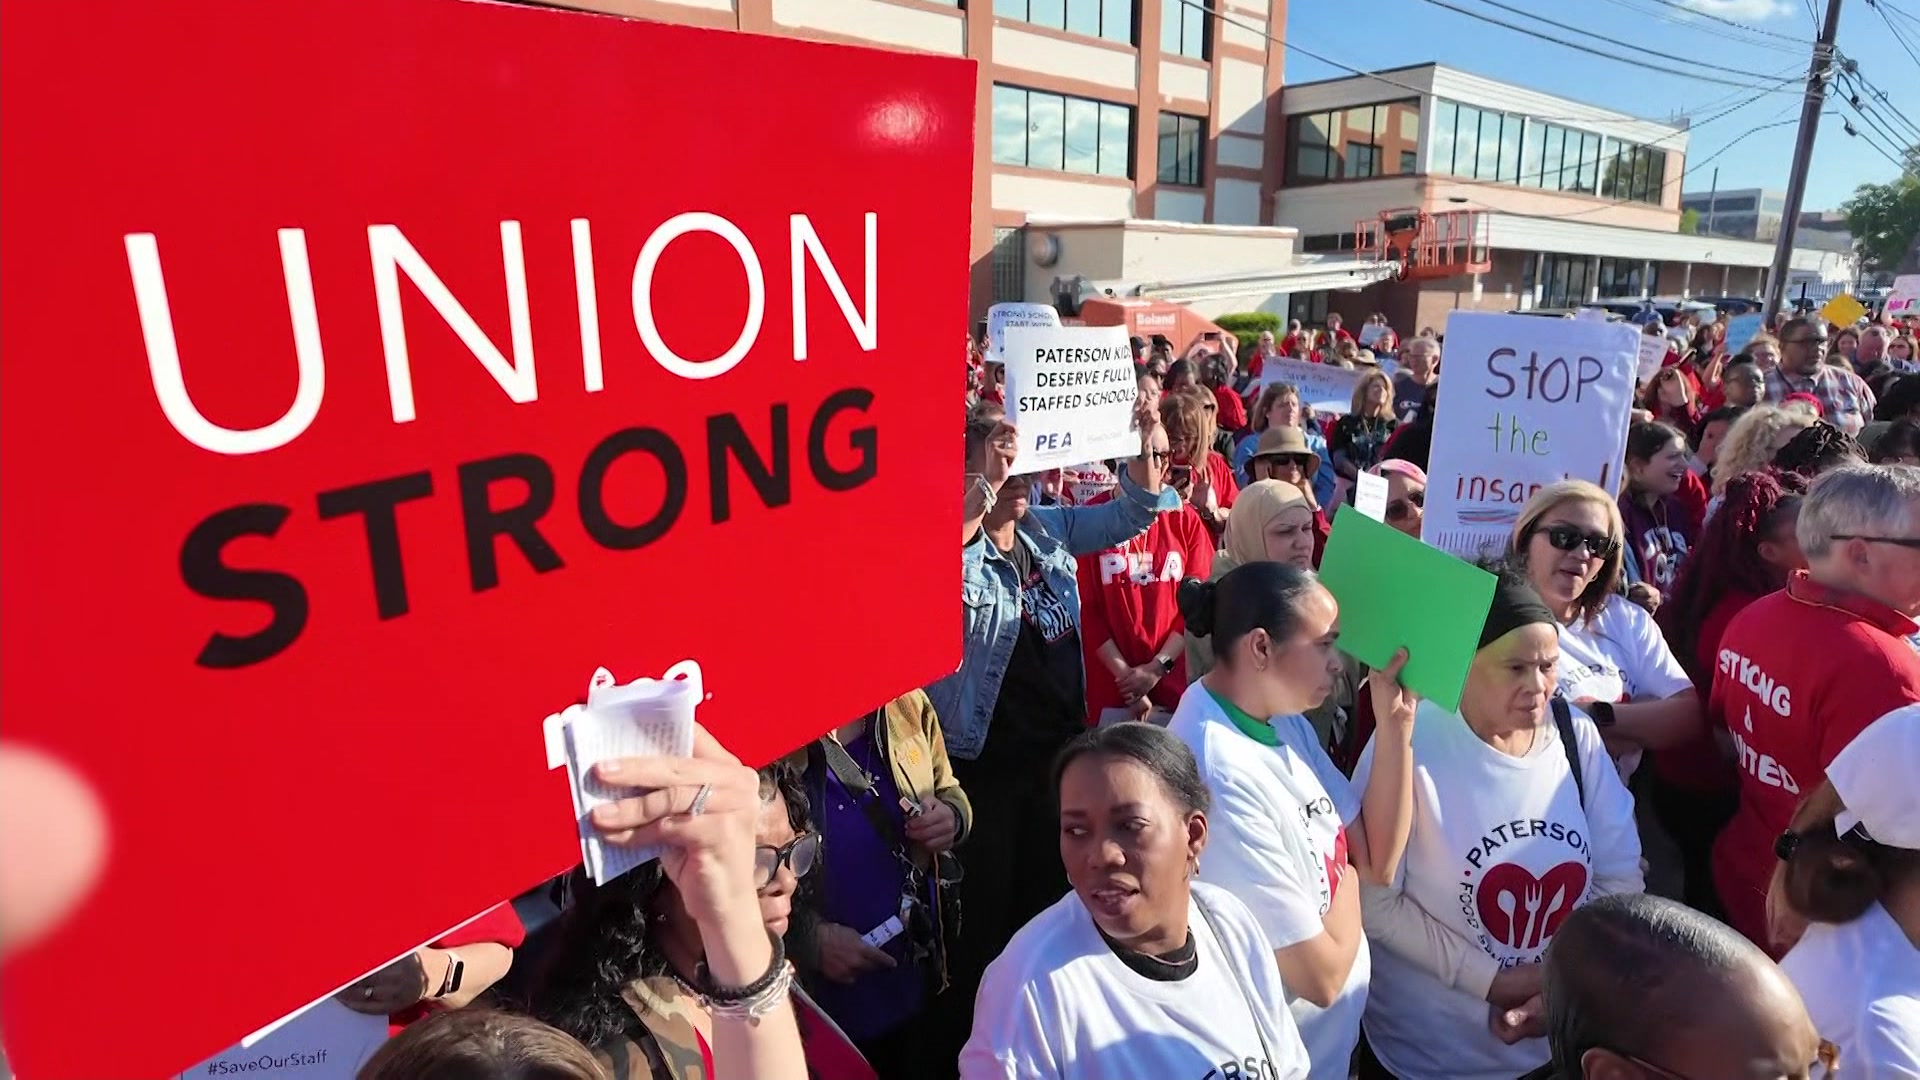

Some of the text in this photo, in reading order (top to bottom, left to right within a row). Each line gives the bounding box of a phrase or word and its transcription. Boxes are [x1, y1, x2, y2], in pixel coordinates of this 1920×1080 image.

[124, 211, 879, 455] UNION
[1036, 347, 1111, 363] PATERSON
[1019, 386, 1136, 412] STAFFED SCHOOLS
[1037, 366, 1132, 387] DESERVE FULLY
[1487, 412, 1551, 456] the
[178, 386, 879, 670] STRONG
[1719, 648, 1791, 717] STRONG
[1728, 726, 1800, 795] NITED
[1465, 818, 1593, 869] PATERSON
[207, 1049, 328, 1076] #SaveOurStaff
